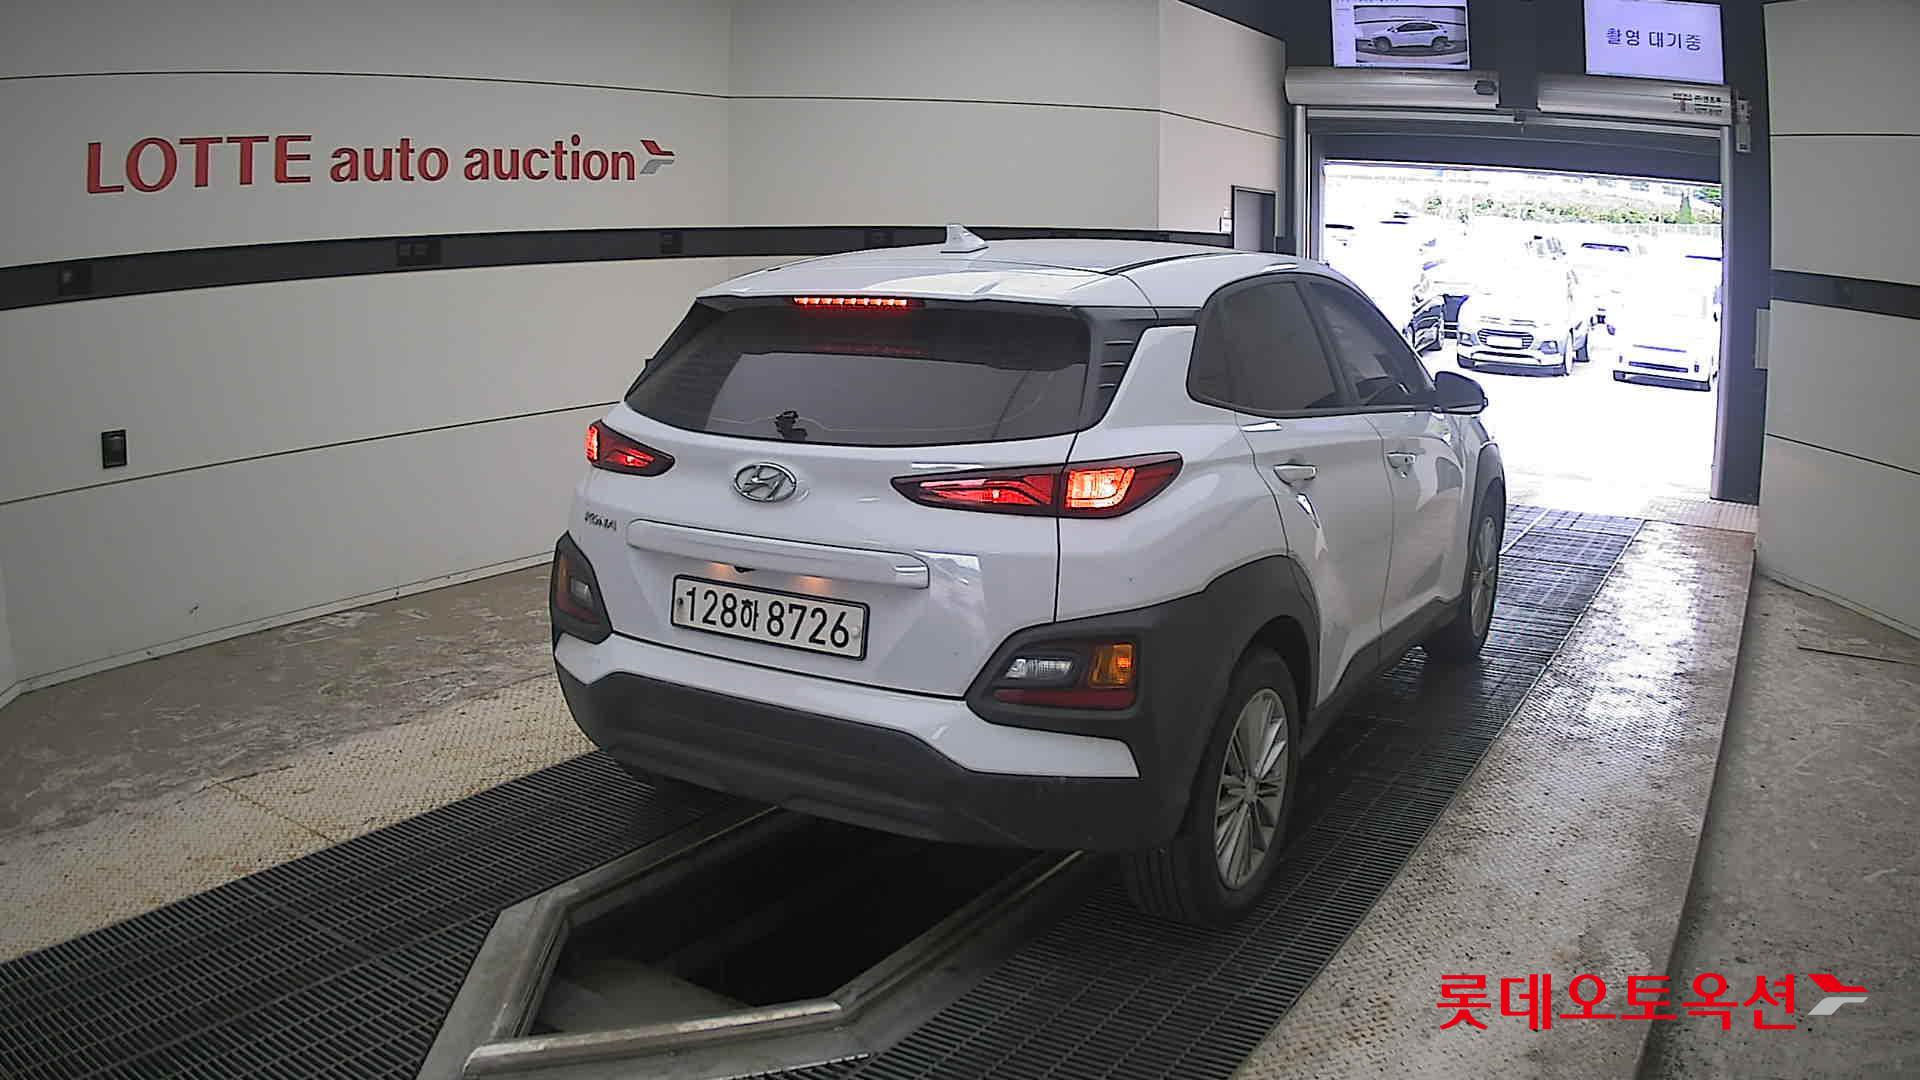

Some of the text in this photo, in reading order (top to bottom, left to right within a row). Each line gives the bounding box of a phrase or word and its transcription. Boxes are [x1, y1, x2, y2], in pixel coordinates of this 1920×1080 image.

[1607, 27, 1701, 51] 촬영 대기중
[87, 134, 635, 194] LOTTE auto auction
